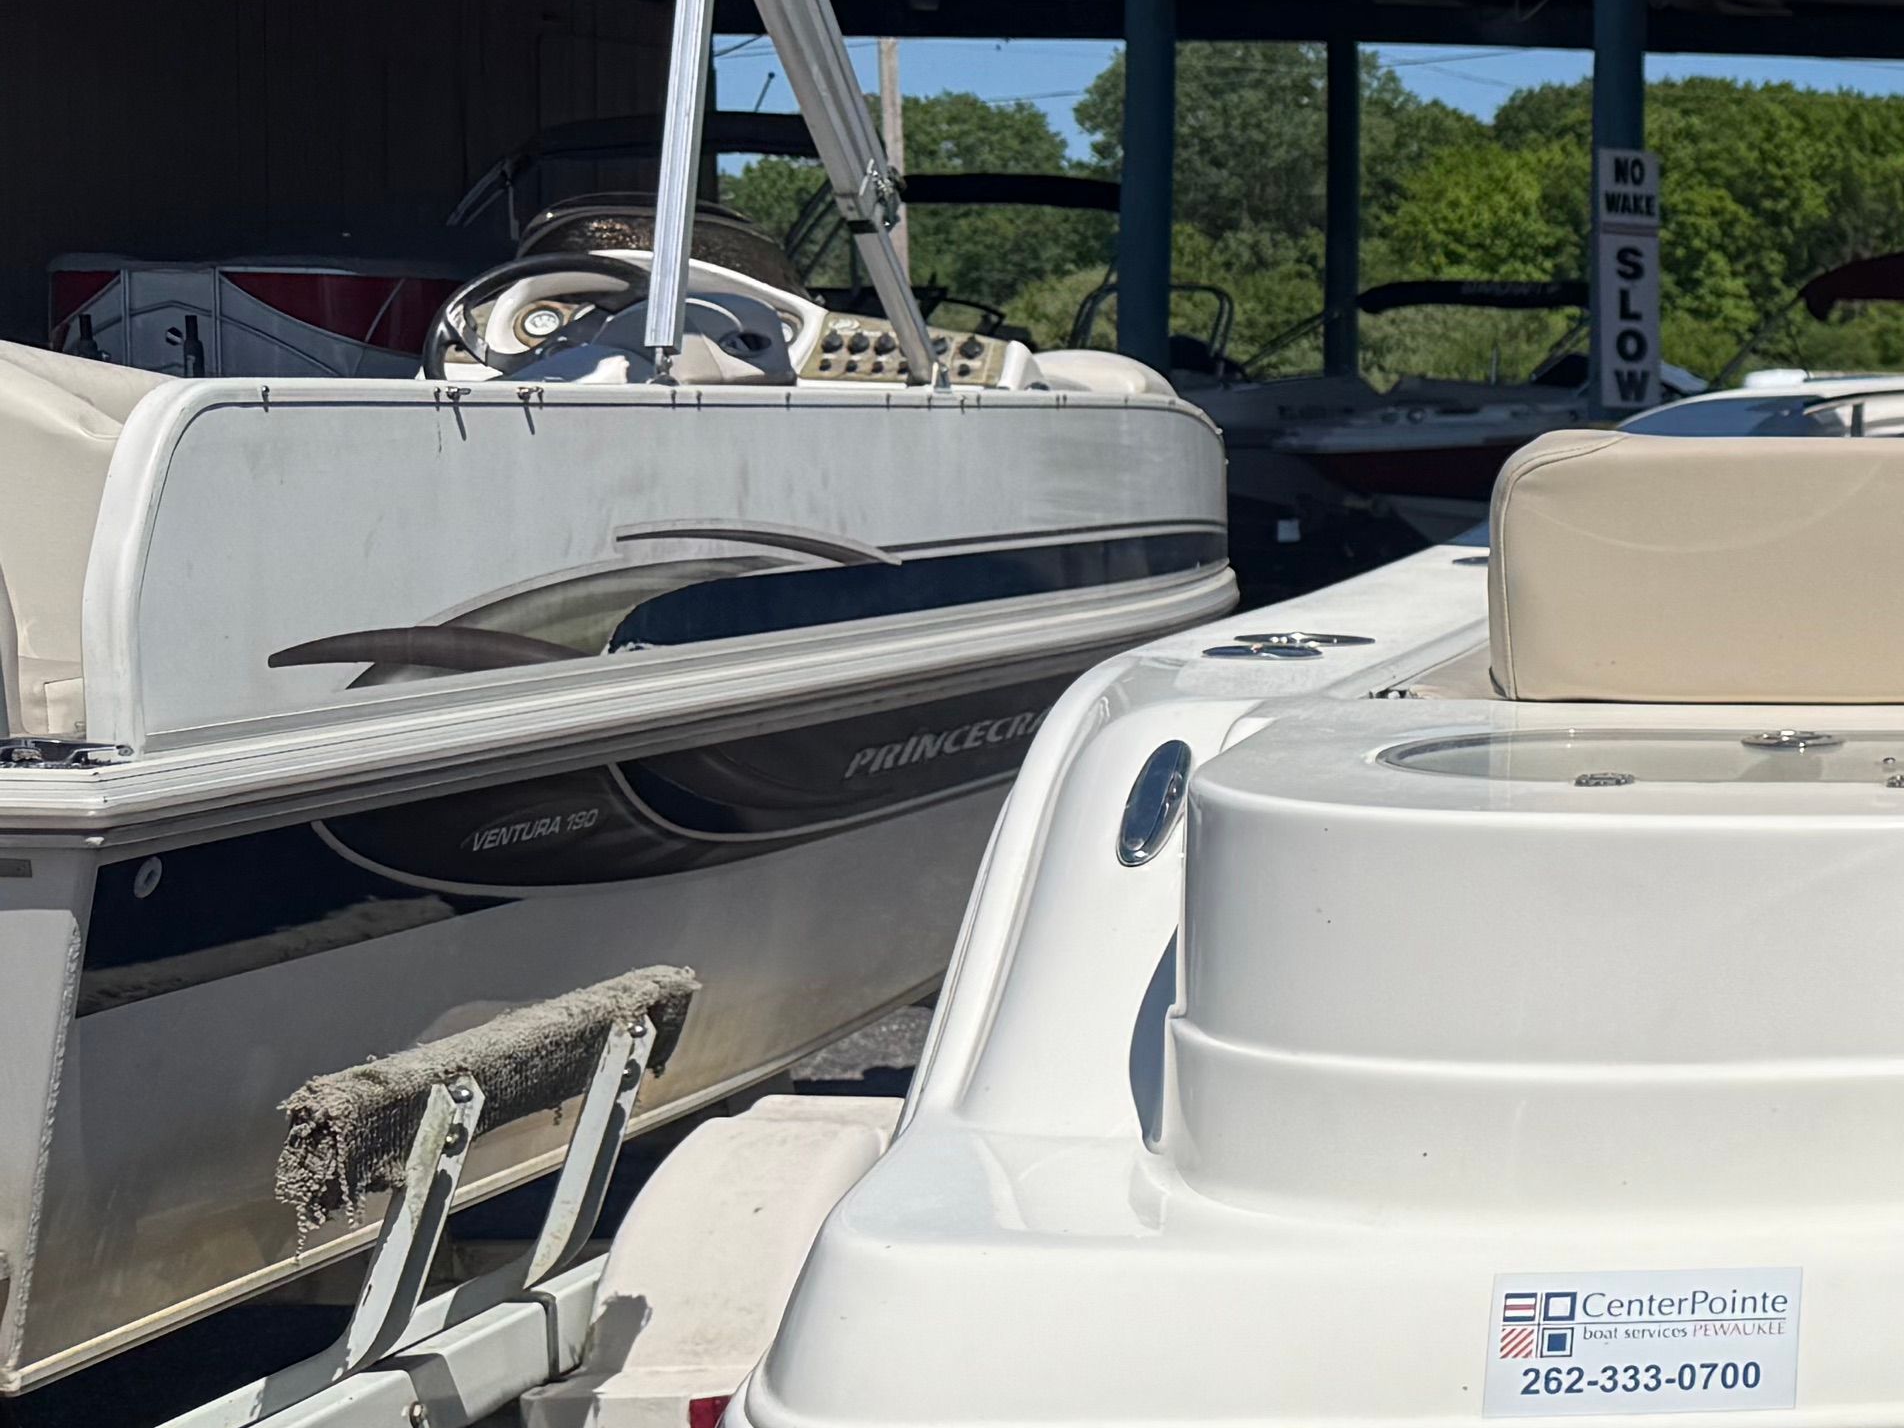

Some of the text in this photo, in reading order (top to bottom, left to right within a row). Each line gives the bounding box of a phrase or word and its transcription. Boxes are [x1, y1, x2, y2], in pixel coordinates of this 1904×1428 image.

[1614, 157, 1645, 186] NO
[1605, 191, 1655, 217] WAKE
[1615, 246, 1649, 402] SLOW
[472, 808, 599, 852] VENTURA 190
[1582, 1289, 1788, 1317] CenterPointe
[1583, 1322, 1787, 1340] boat services PEWAUKEE
[1521, 1361, 1761, 1395] 262-333-0700
